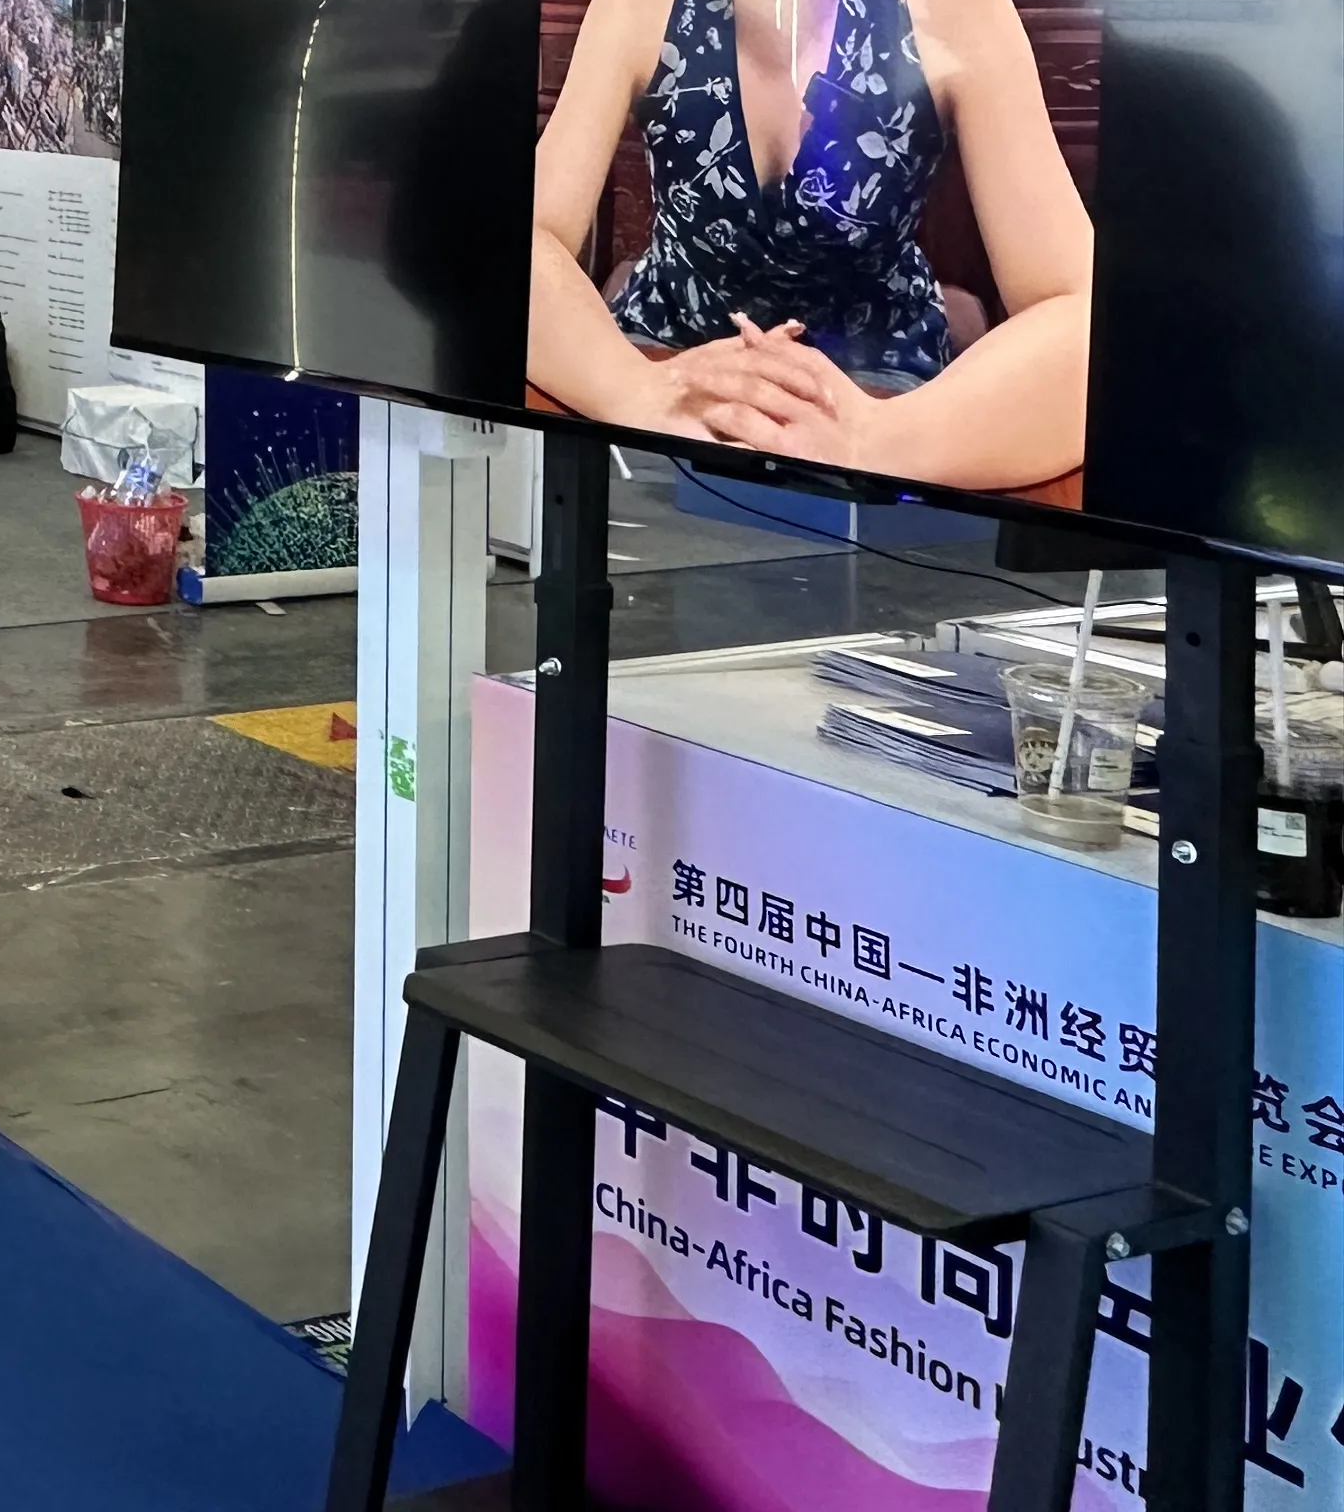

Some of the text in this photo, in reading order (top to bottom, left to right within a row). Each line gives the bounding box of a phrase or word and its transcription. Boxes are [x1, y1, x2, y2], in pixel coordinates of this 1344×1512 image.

[603, 826, 638, 851] ETE
[671, 914, 709, 945] THE
[712, 931, 795, 978] FOURTH
[800, 964, 967, 1046] CHINA-AFRICA
[973, 1031, 1108, 1102] ECONOMIC
[1113, 1087, 1154, 1119] AN
[1281, 1151, 1344, 1196] EXP
[595, 1181, 813, 1322] China-Africa
[825, 1296, 982, 1411] Fashion
